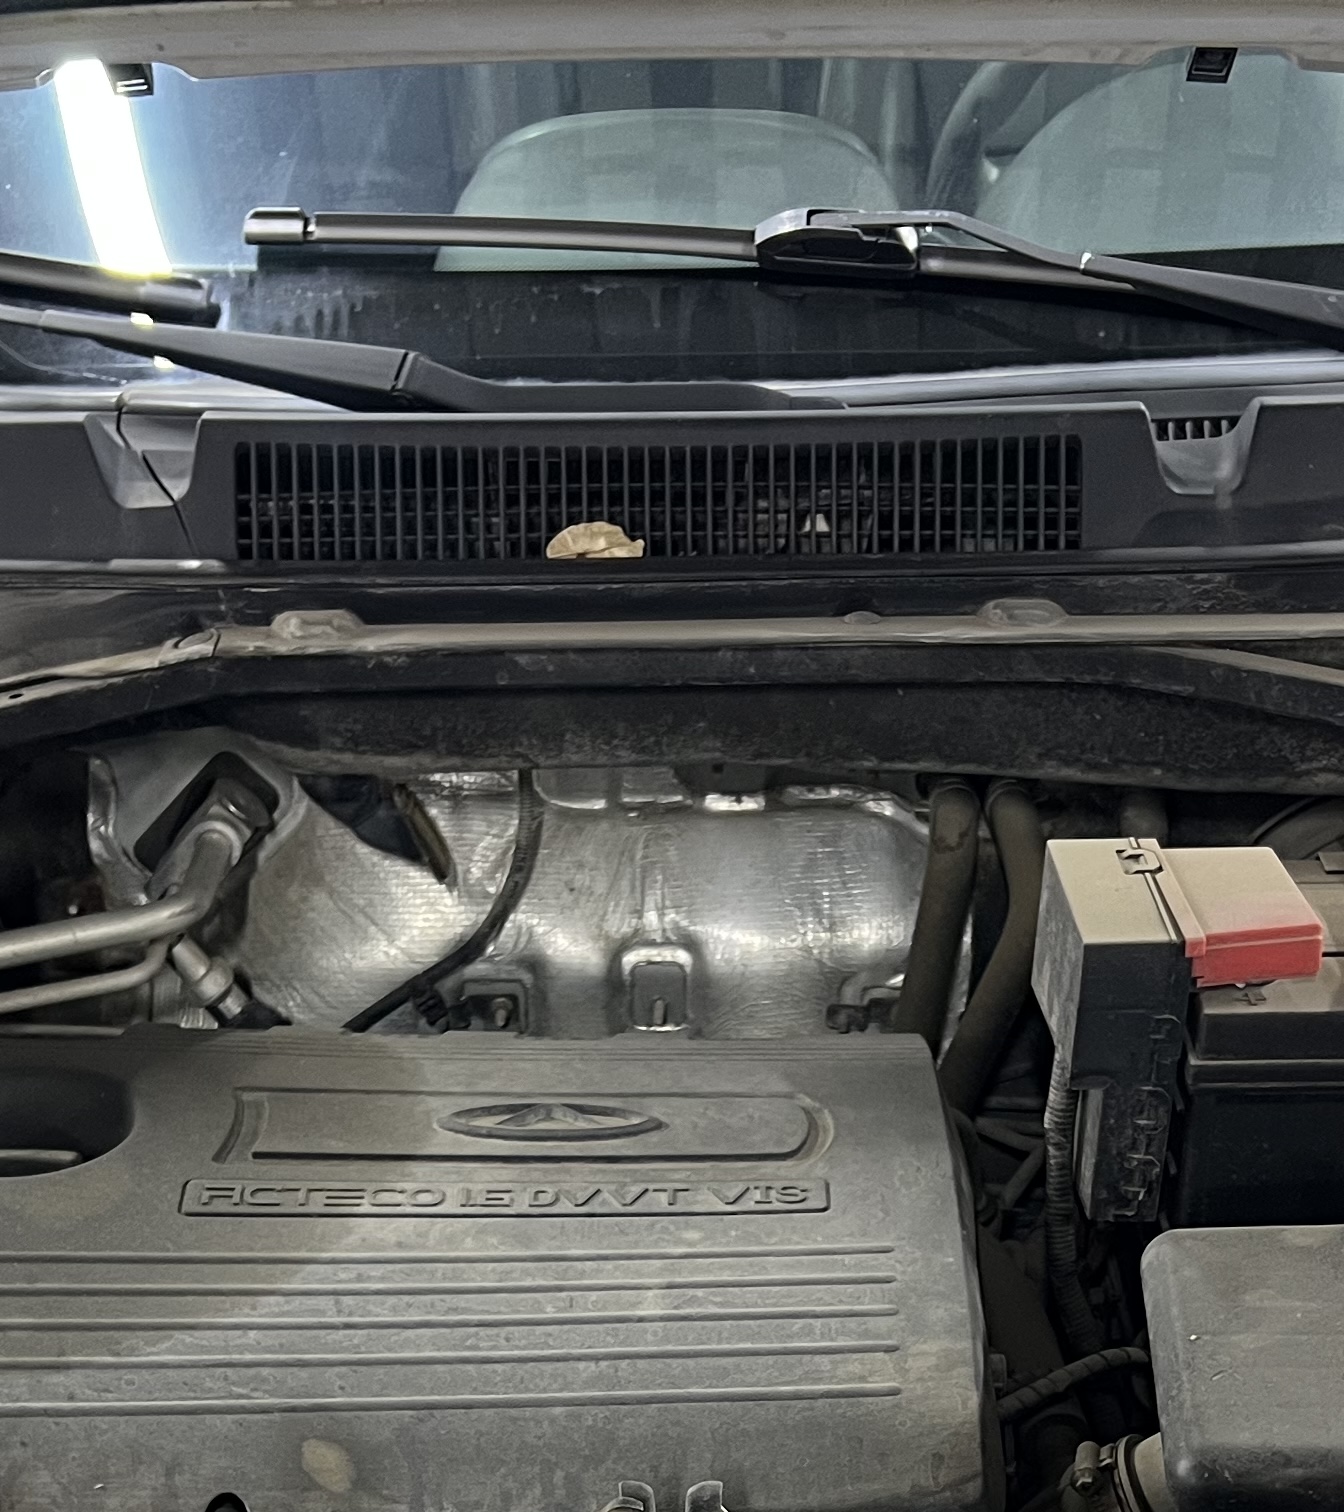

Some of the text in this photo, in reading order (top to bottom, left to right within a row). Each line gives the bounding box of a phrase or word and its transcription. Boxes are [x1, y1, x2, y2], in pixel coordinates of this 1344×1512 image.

[199, 1184, 447, 1207] ACTECO
[527, 1186, 691, 1208] DVVT
[706, 1185, 810, 1206] VIS
